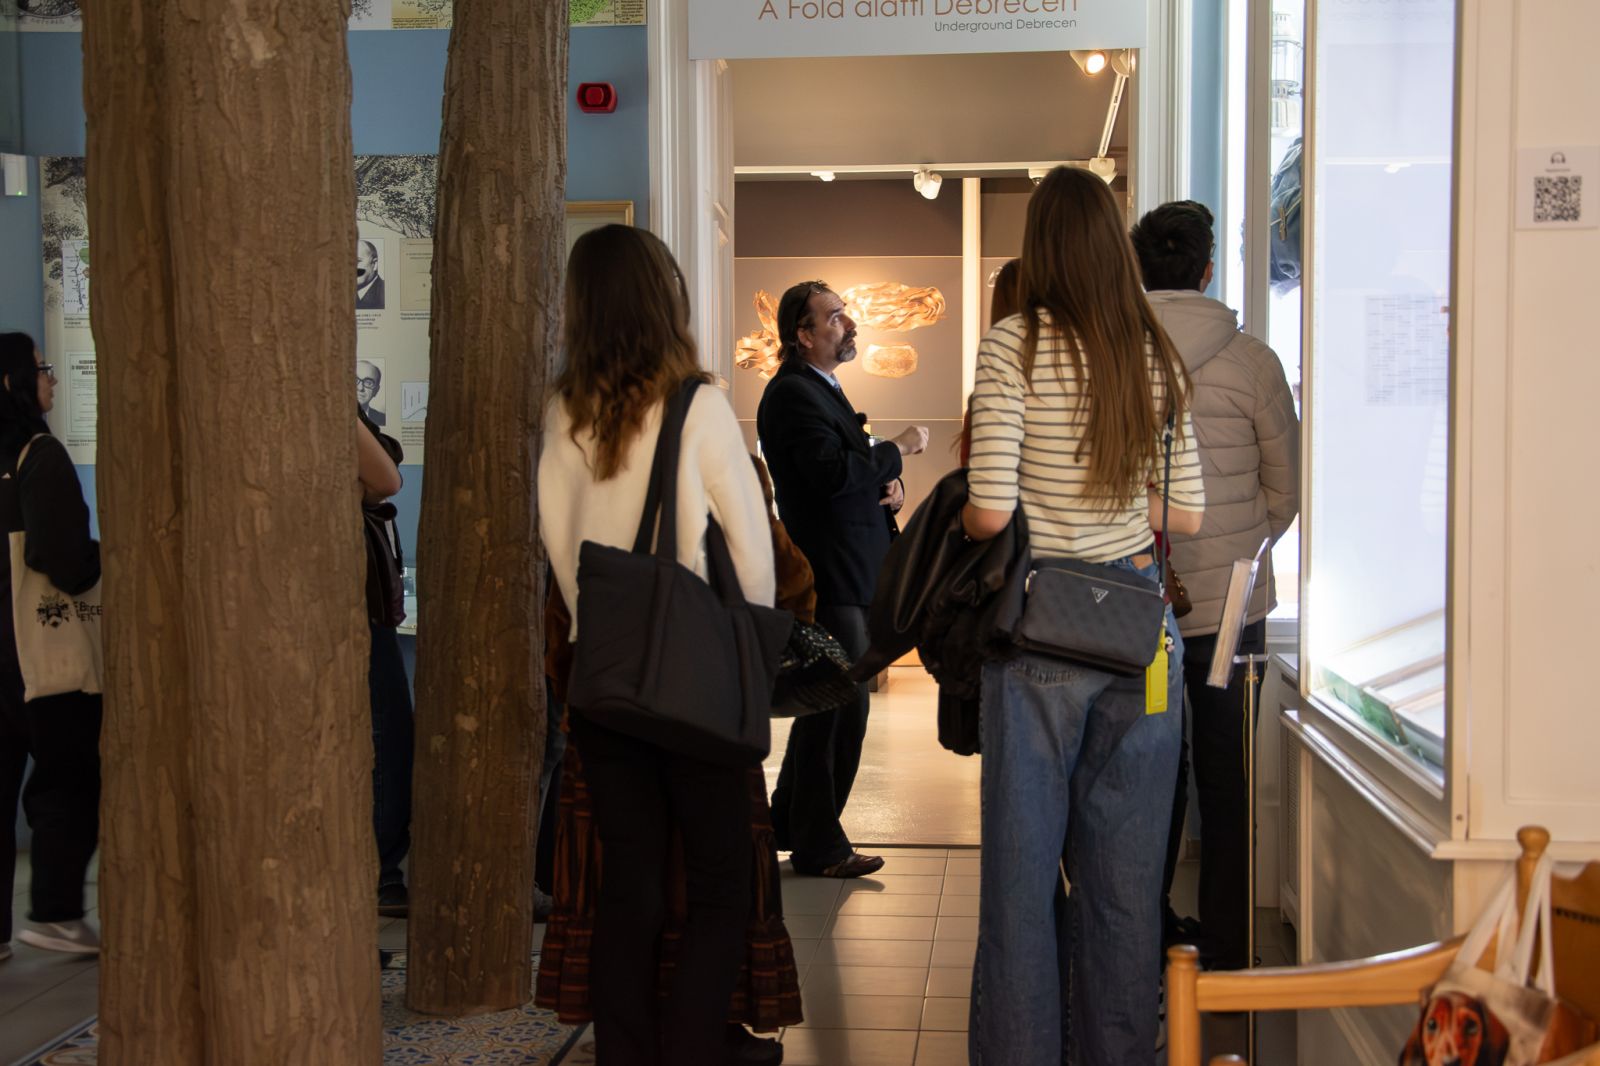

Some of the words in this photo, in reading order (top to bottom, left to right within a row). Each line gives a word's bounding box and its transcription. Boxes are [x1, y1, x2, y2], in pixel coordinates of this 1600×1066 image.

[758, 0, 779, 20] A
[934, 0, 1077, 16] Debrecen
[934, 19, 1013, 33] Underground
[1016, 18, 1077, 30] Debrecen
